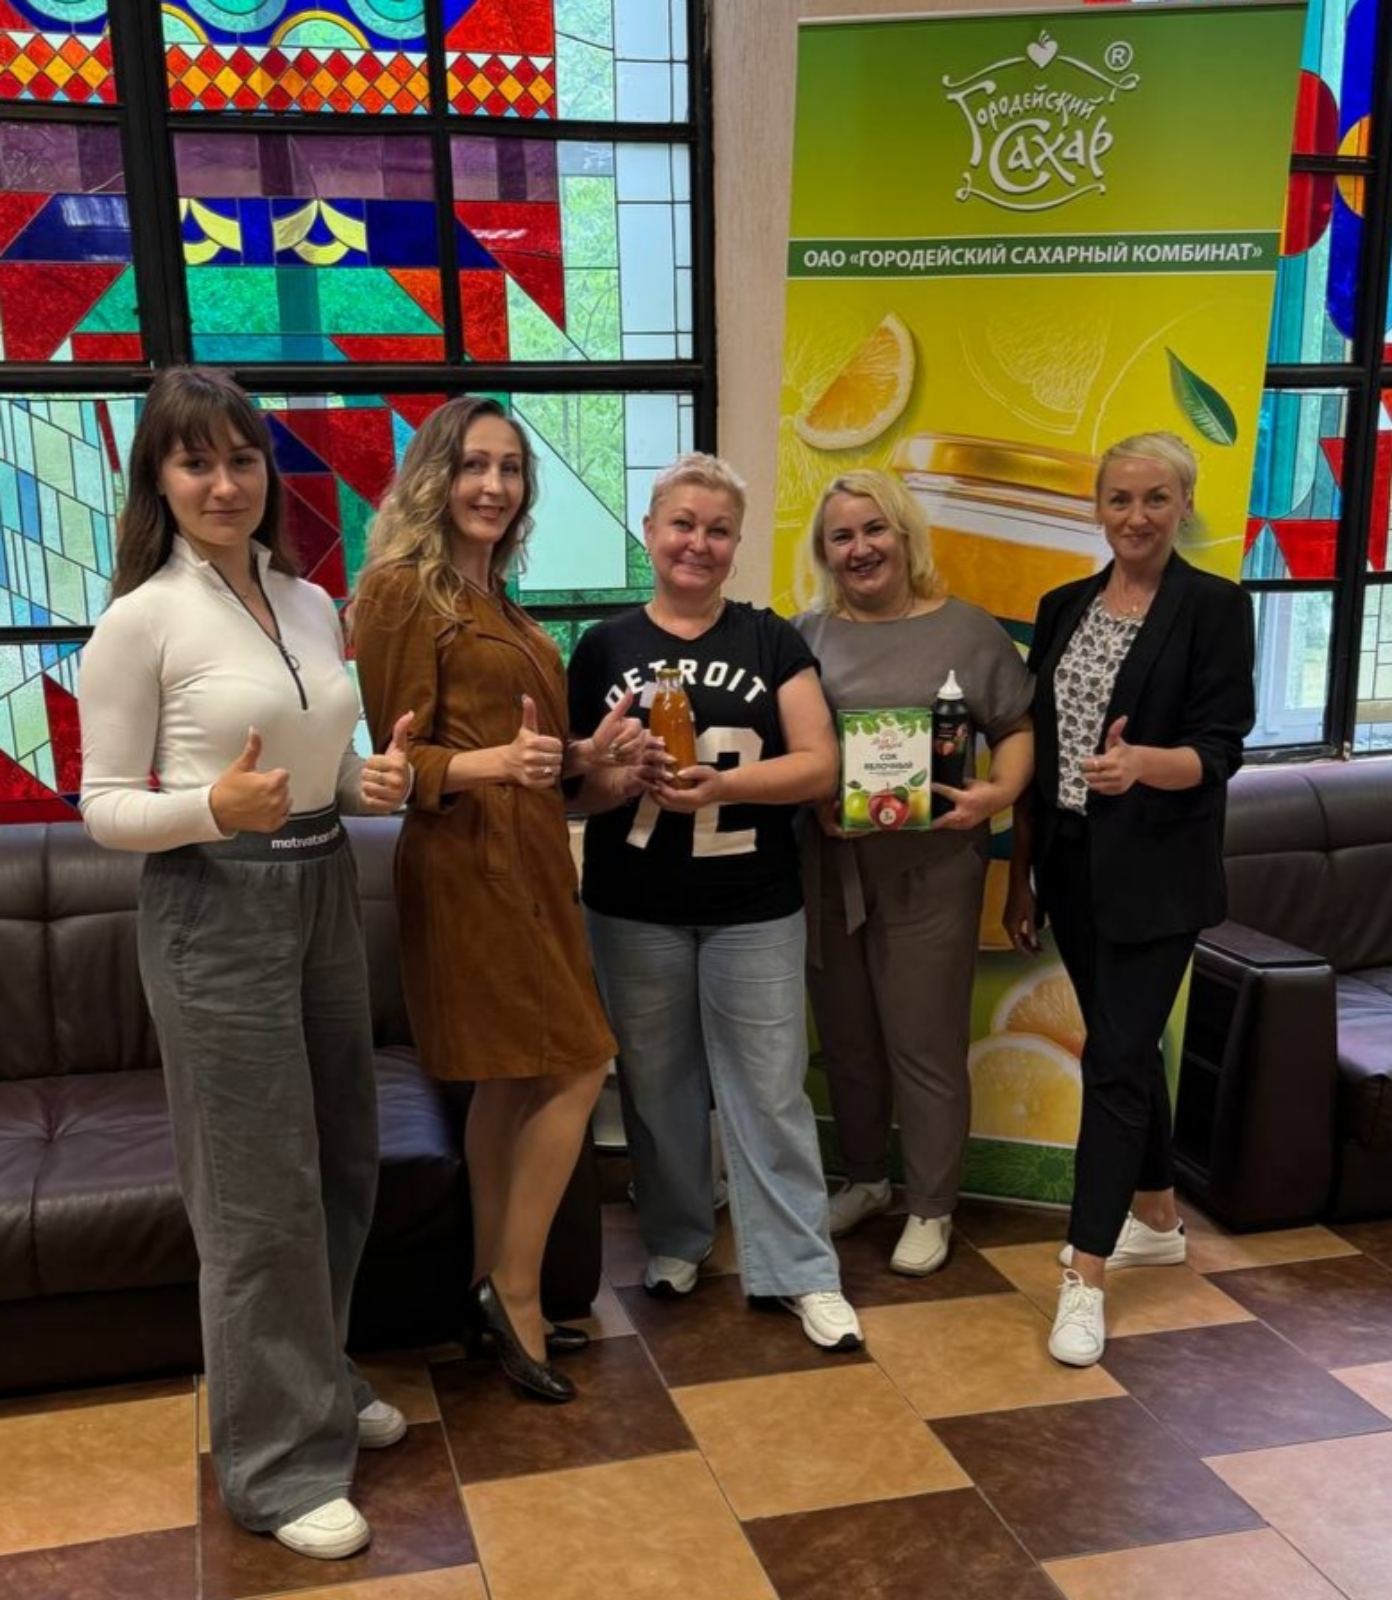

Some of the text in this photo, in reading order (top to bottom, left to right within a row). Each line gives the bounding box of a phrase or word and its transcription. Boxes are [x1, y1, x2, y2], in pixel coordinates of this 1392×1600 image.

[803, 242, 1262, 270] ОАО «ГОРОДЕЙСКИЙ САХАРНЫЙ КОМБИНАТ»
[604, 658, 767, 711] DETROIT
[879, 753, 898, 761] СОК
